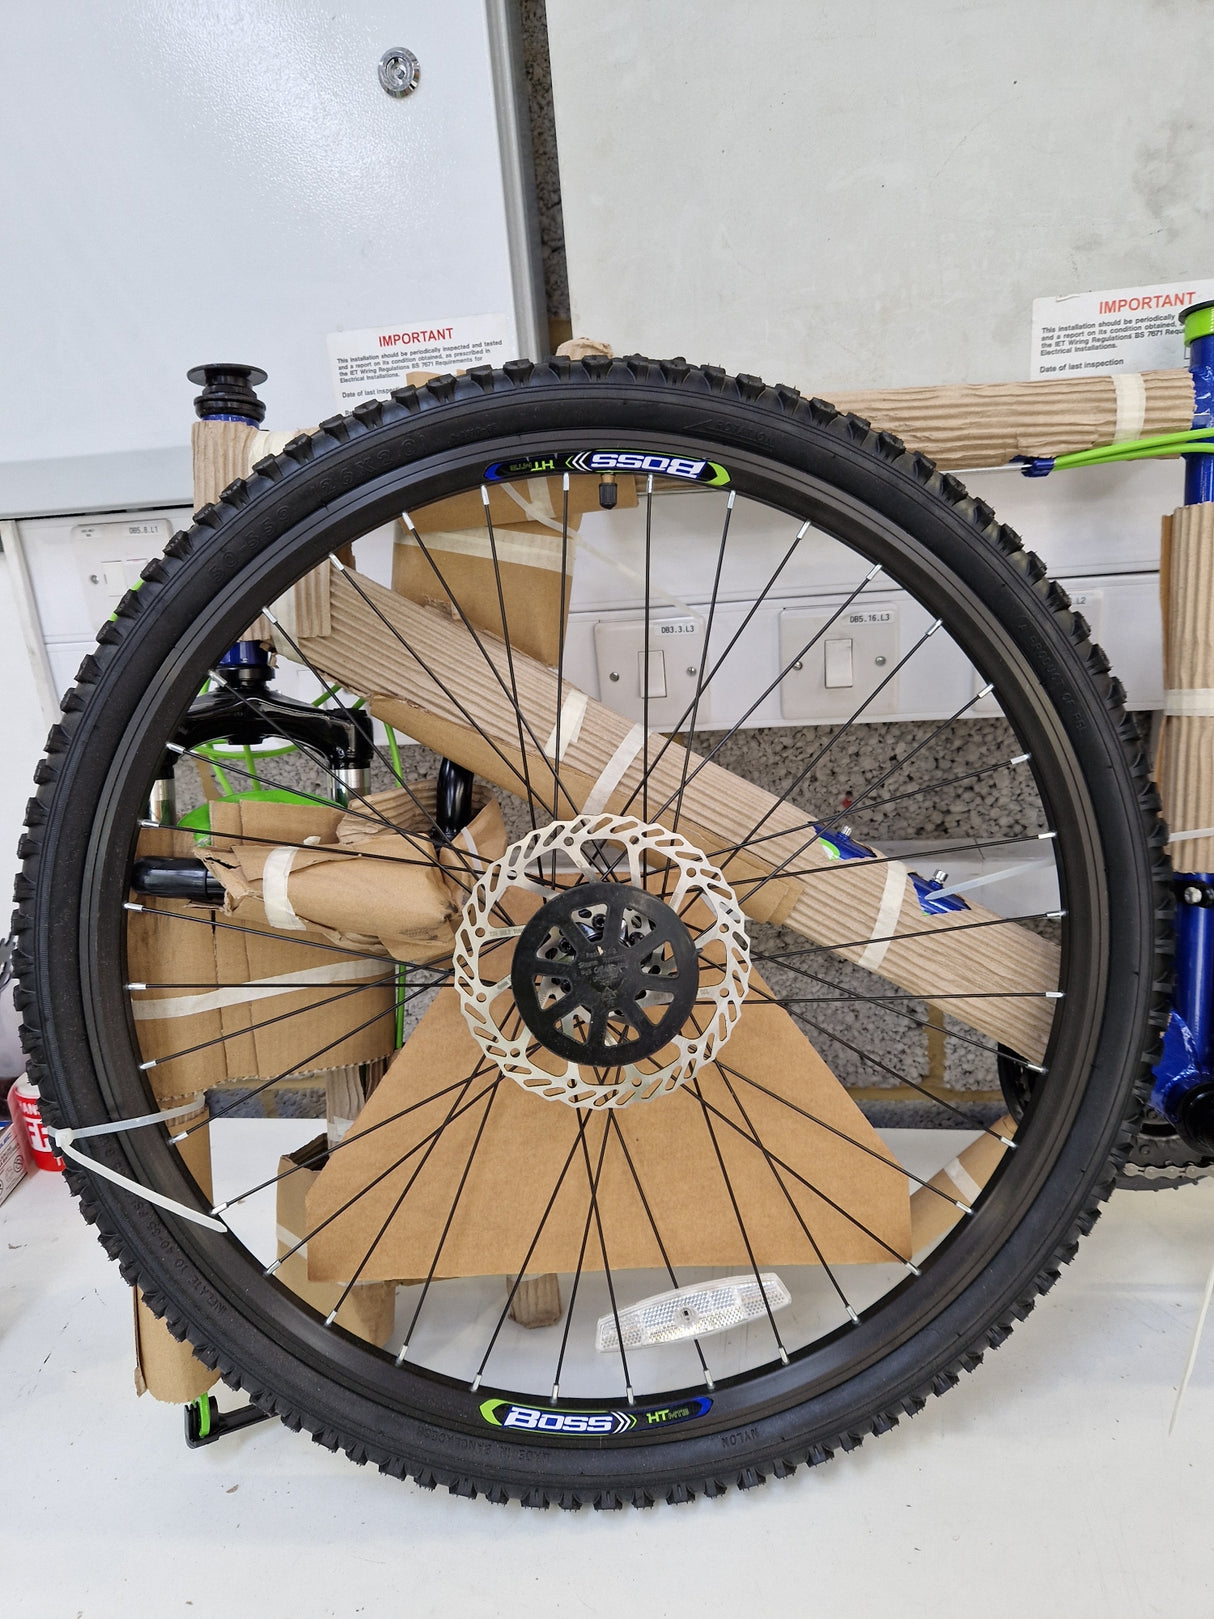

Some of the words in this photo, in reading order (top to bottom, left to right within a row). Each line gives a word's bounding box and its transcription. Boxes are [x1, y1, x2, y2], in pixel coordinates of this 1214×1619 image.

[1099, 291, 1196, 314] IMPORTANT
[1058, 323, 1095, 332] installation
[1099, 319, 1121, 327] should
[1135, 314, 1175, 323] periodically
[378, 327, 453, 348] IMPORTANT
[1063, 331, 1084, 339] report
[1110, 325, 1141, 334] condition
[1092, 334, 1132, 343] Regulations
[410, 347, 441, 356] periodically
[442, 344, 470, 352] inspected
[454, 349, 484, 357] prescribed
[1040, 347, 1072, 356] Electrical
[435, 357, 473, 366] Requirements
[1084, 359, 1124, 368] inspection
[591, 453, 708, 479] BOSS
[503, 1406, 614, 1432] BOSS
